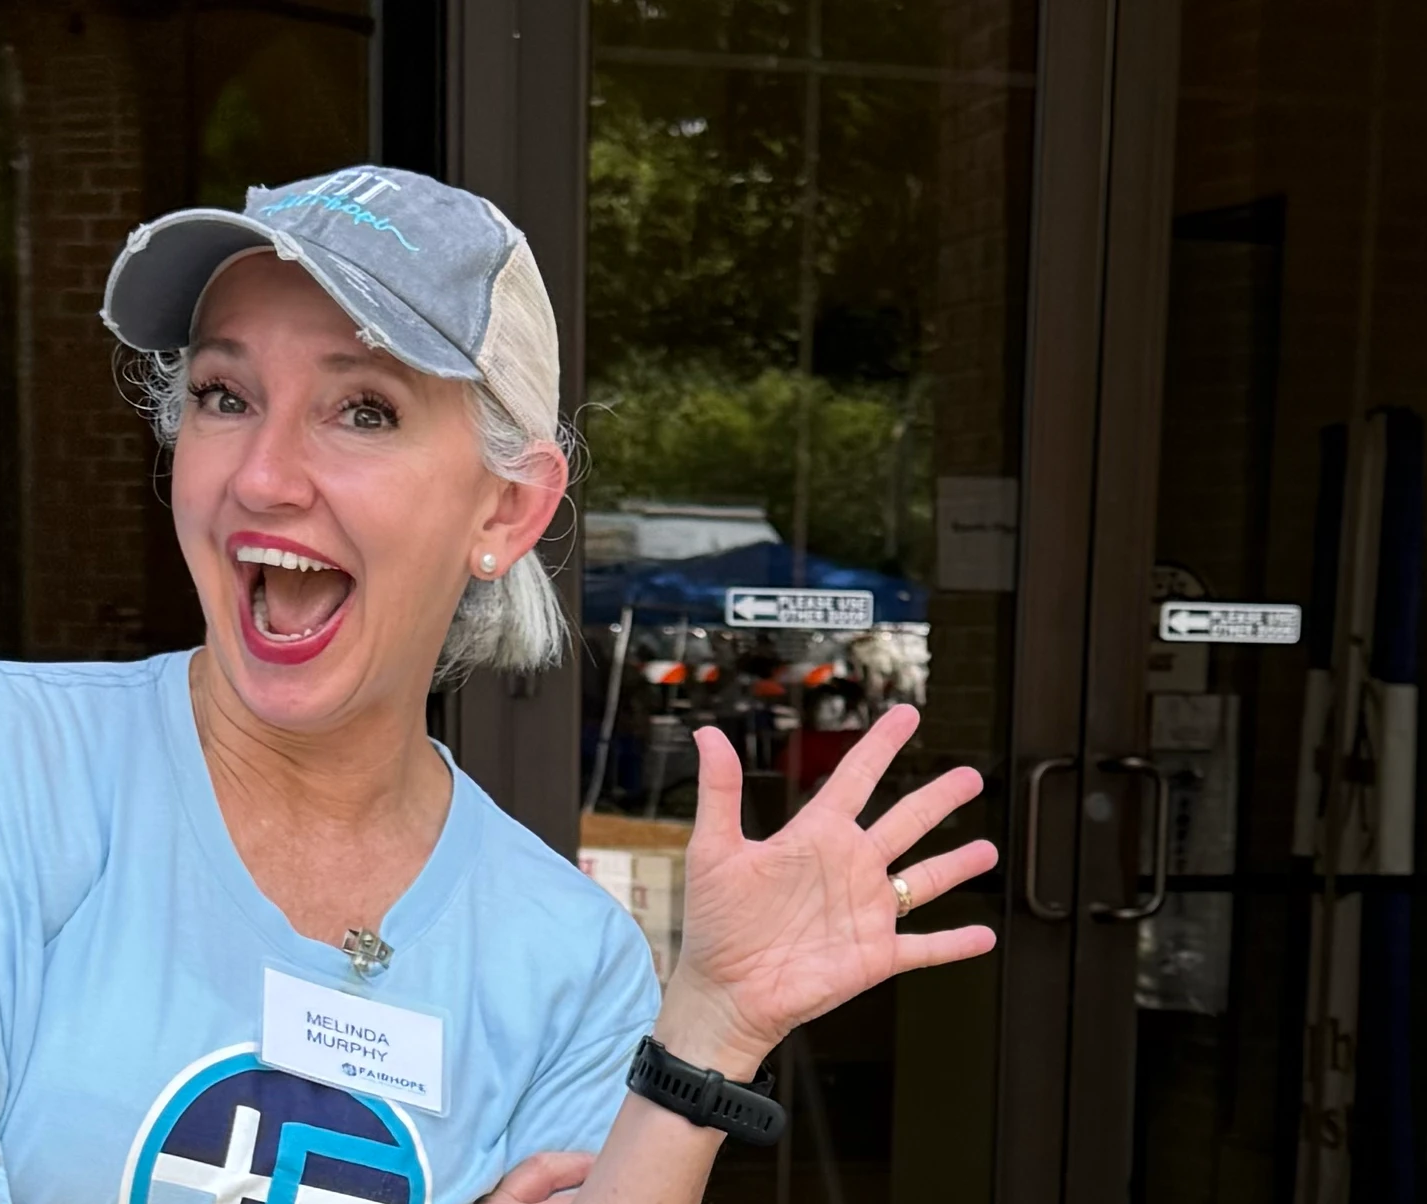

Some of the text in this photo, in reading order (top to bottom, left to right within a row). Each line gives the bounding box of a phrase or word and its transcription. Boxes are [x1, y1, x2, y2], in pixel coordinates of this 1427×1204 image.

[307, 170, 402, 205] FIT
[306, 1010, 390, 1046] MELINDA
[306, 1029, 388, 1063] MURPHY
